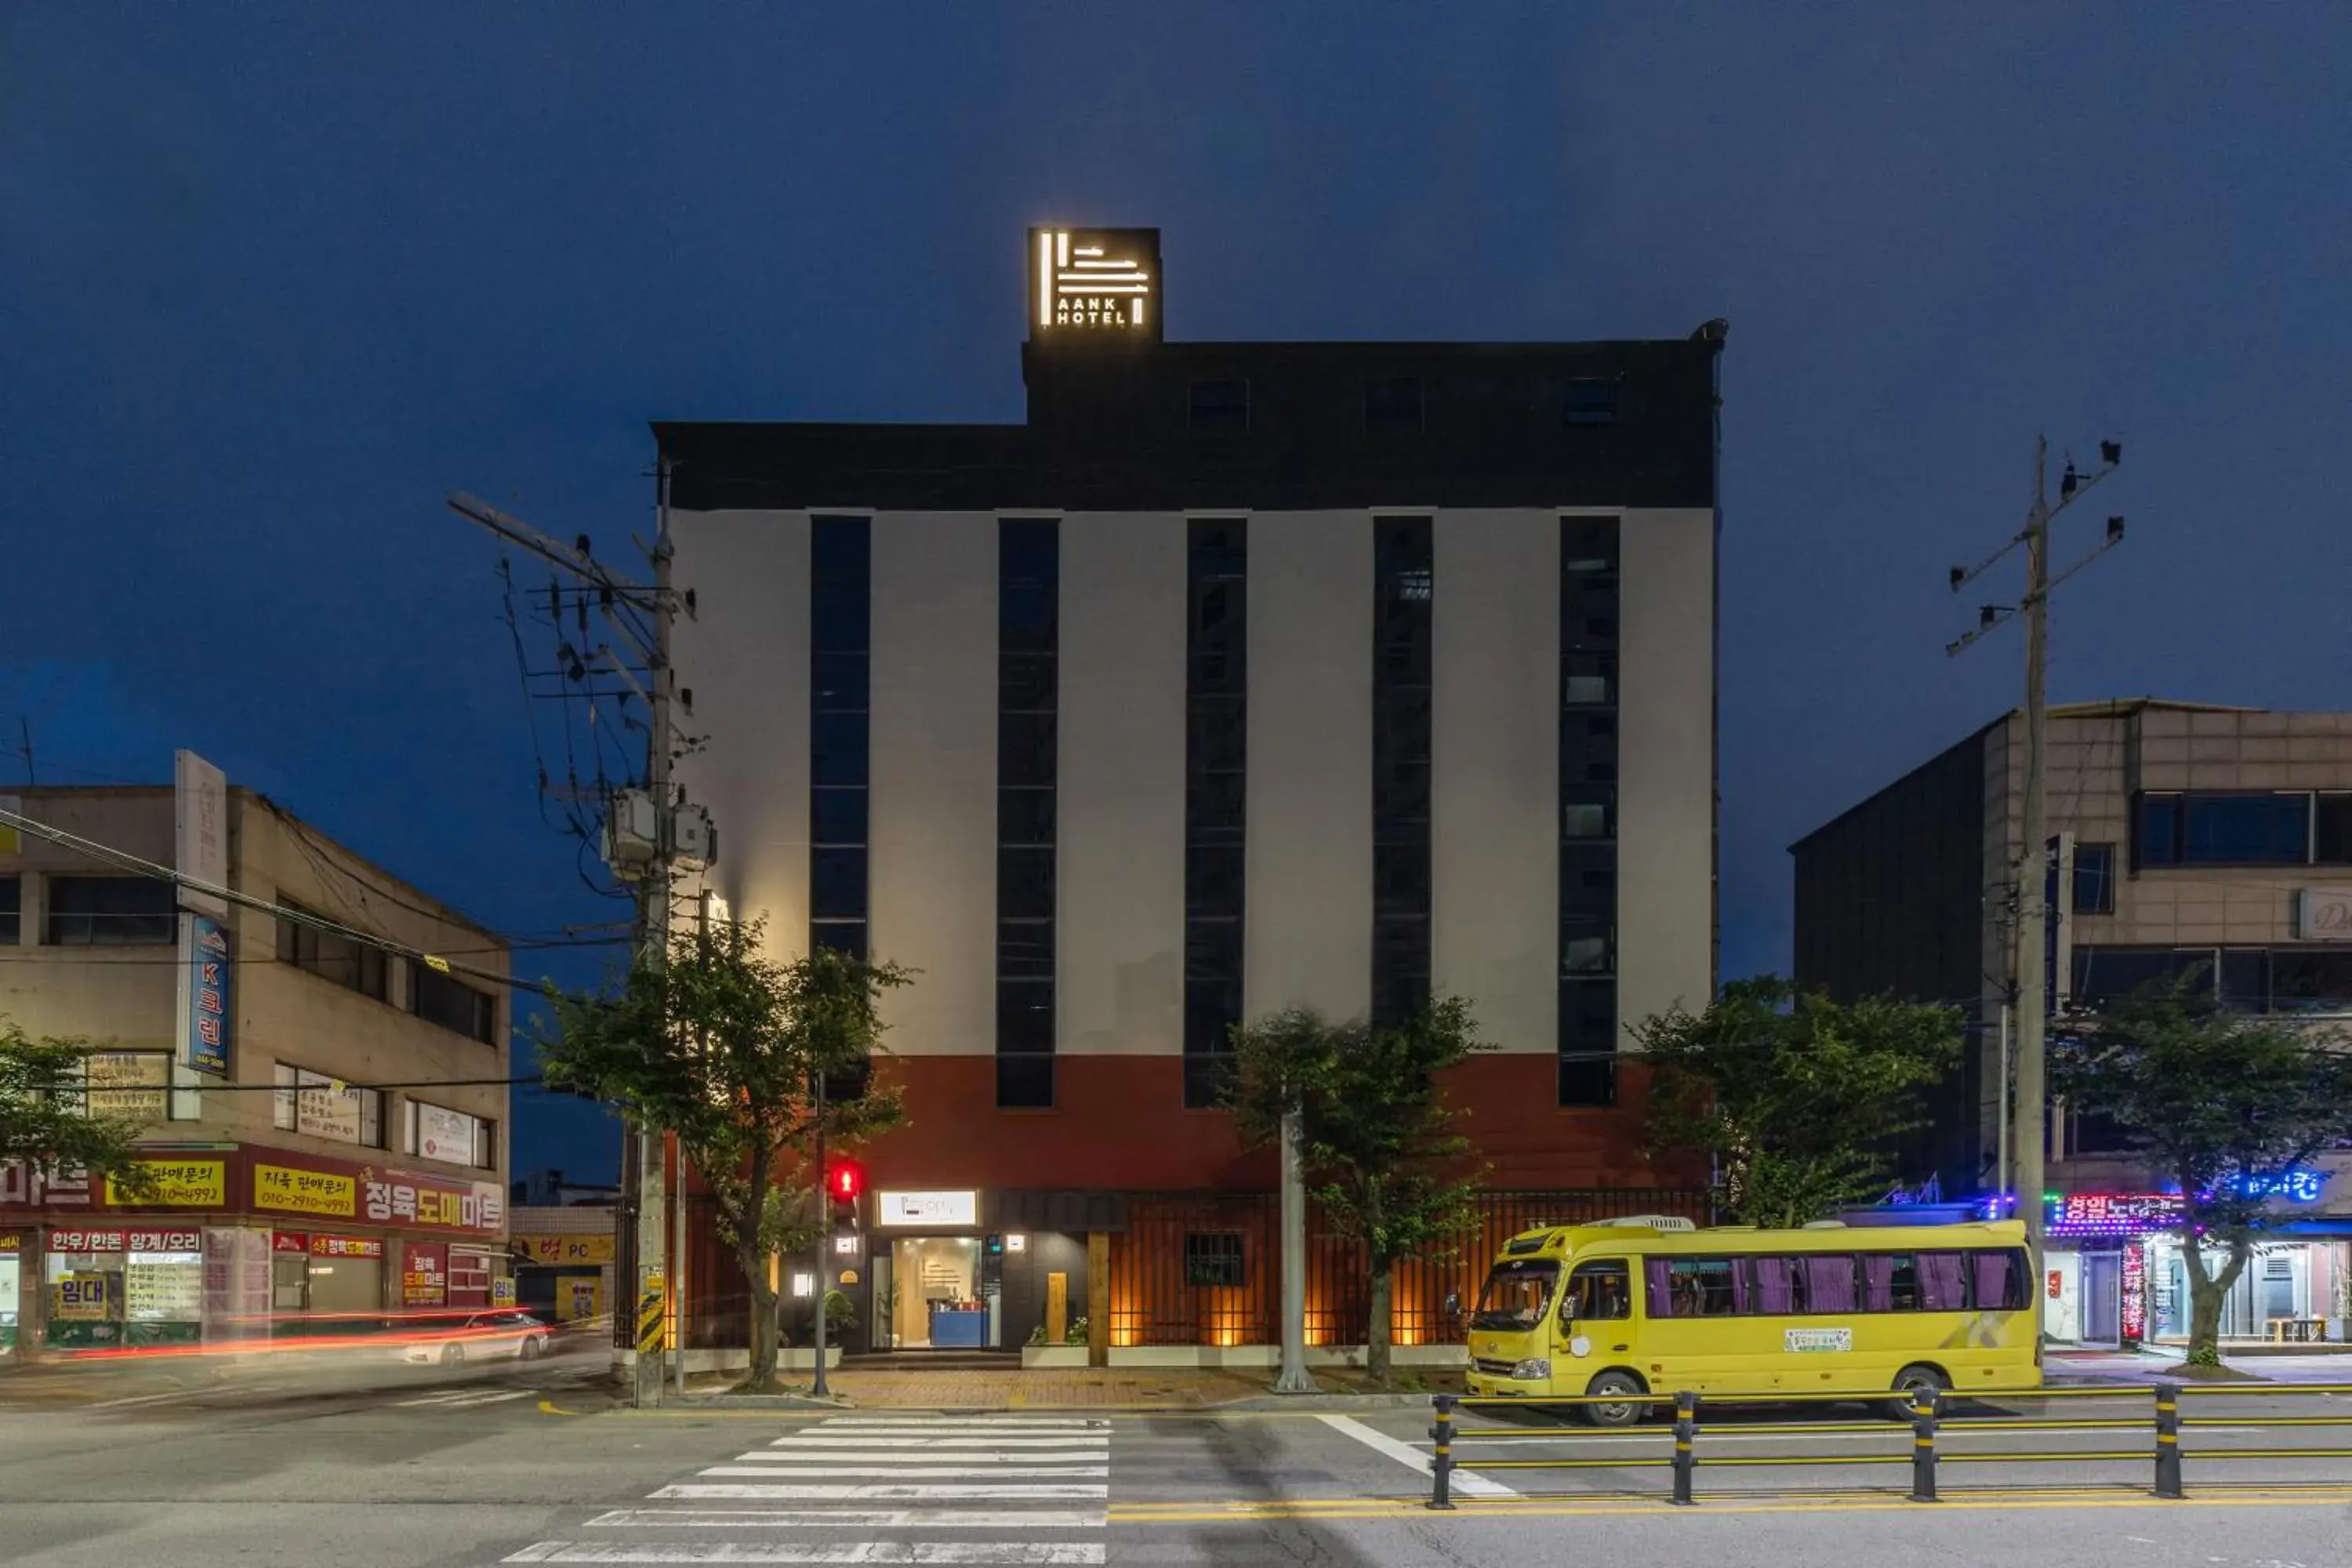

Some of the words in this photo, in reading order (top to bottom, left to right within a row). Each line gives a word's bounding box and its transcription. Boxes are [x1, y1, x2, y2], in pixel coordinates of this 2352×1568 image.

[1058, 298, 1116, 310] AANK
[1057, 312, 1126, 325] HOTEL
[297, 1176, 348, 1195] 판매문의
[261, 1192, 351, 1213] 010-2910-4992
[365, 1180, 504, 1229] 정육도매마트
[52, 1232, 122, 1251] 한우/한돈
[569, 1243, 589, 1258] PC
[62, 1279, 103, 1303] 임대
